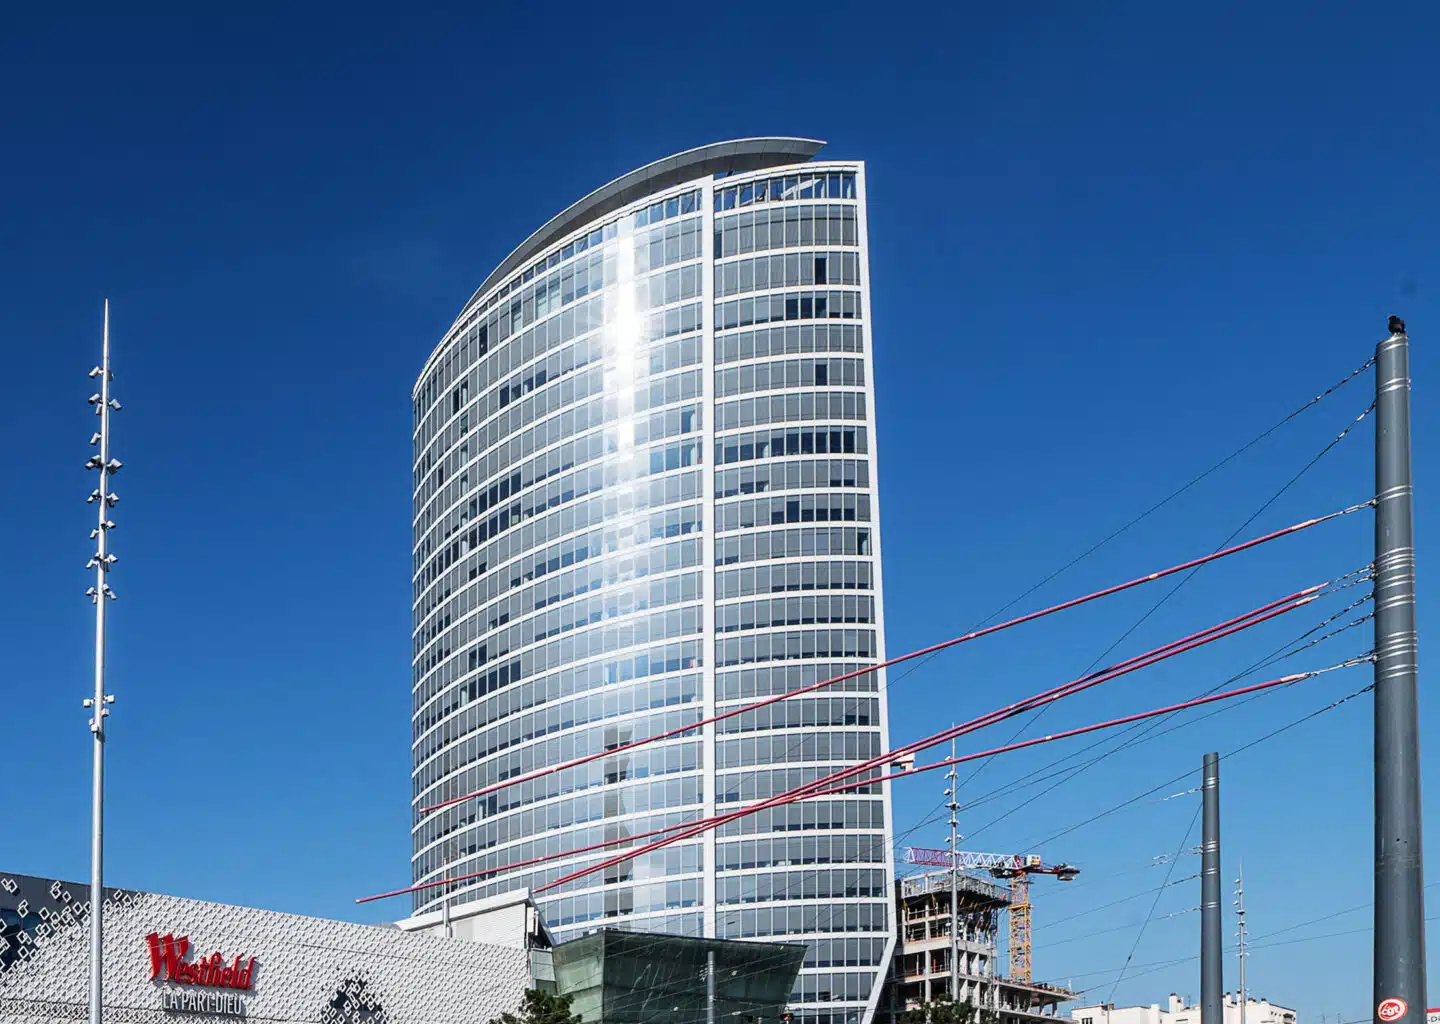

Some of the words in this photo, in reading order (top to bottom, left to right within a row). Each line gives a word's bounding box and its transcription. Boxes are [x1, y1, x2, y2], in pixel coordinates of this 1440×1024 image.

[145, 931, 257, 990] Westfield
[162, 990, 178, 1010] LA
[181, 990, 242, 1015] PART-DIEU
